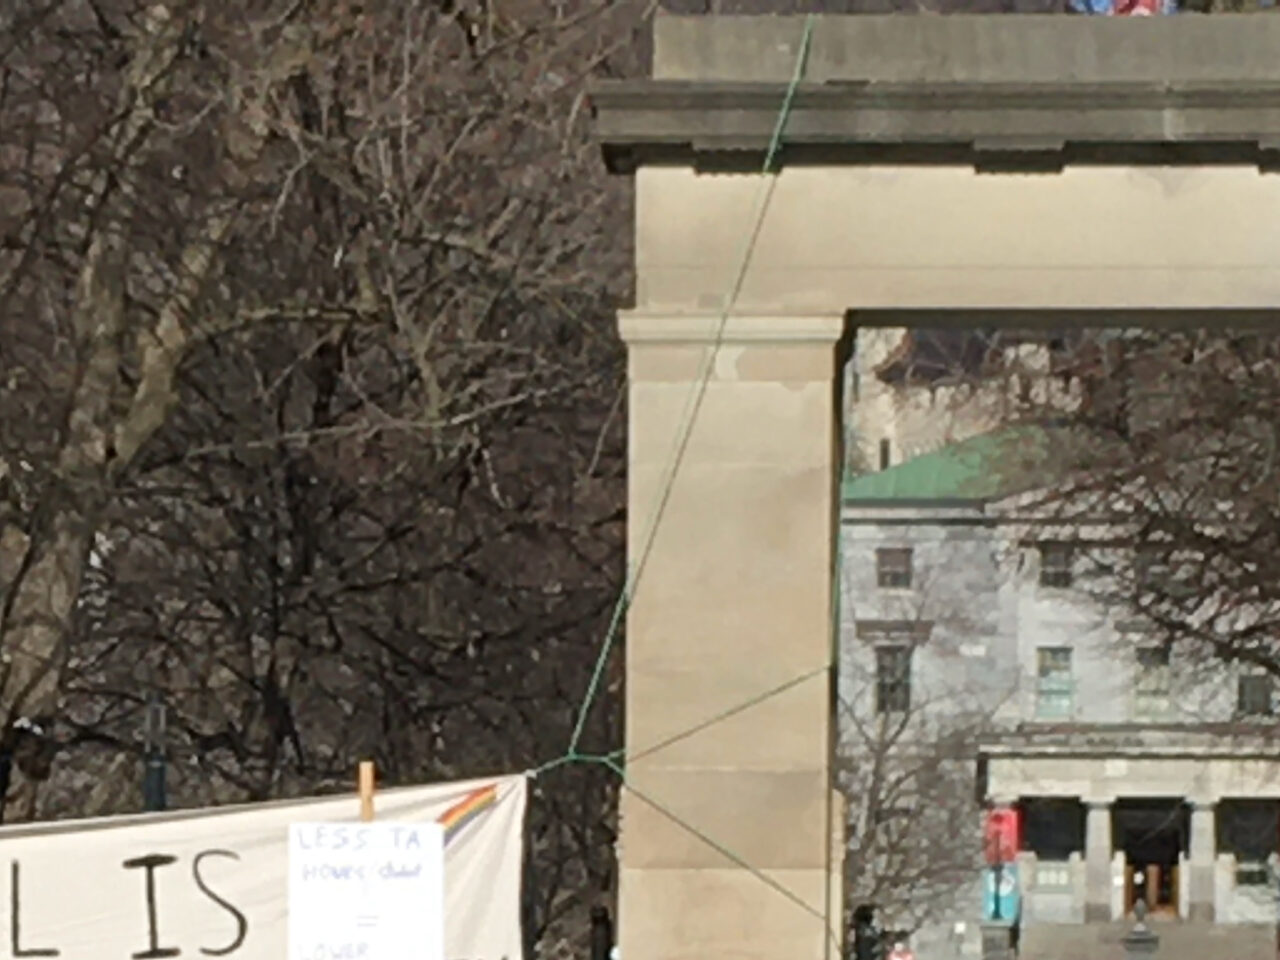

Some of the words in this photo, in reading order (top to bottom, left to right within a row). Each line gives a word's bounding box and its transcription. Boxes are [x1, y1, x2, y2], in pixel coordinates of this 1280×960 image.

[297, 825, 370, 851] LESS
[389, 826, 422, 850] TA
[122, 848, 249, 960] IS
